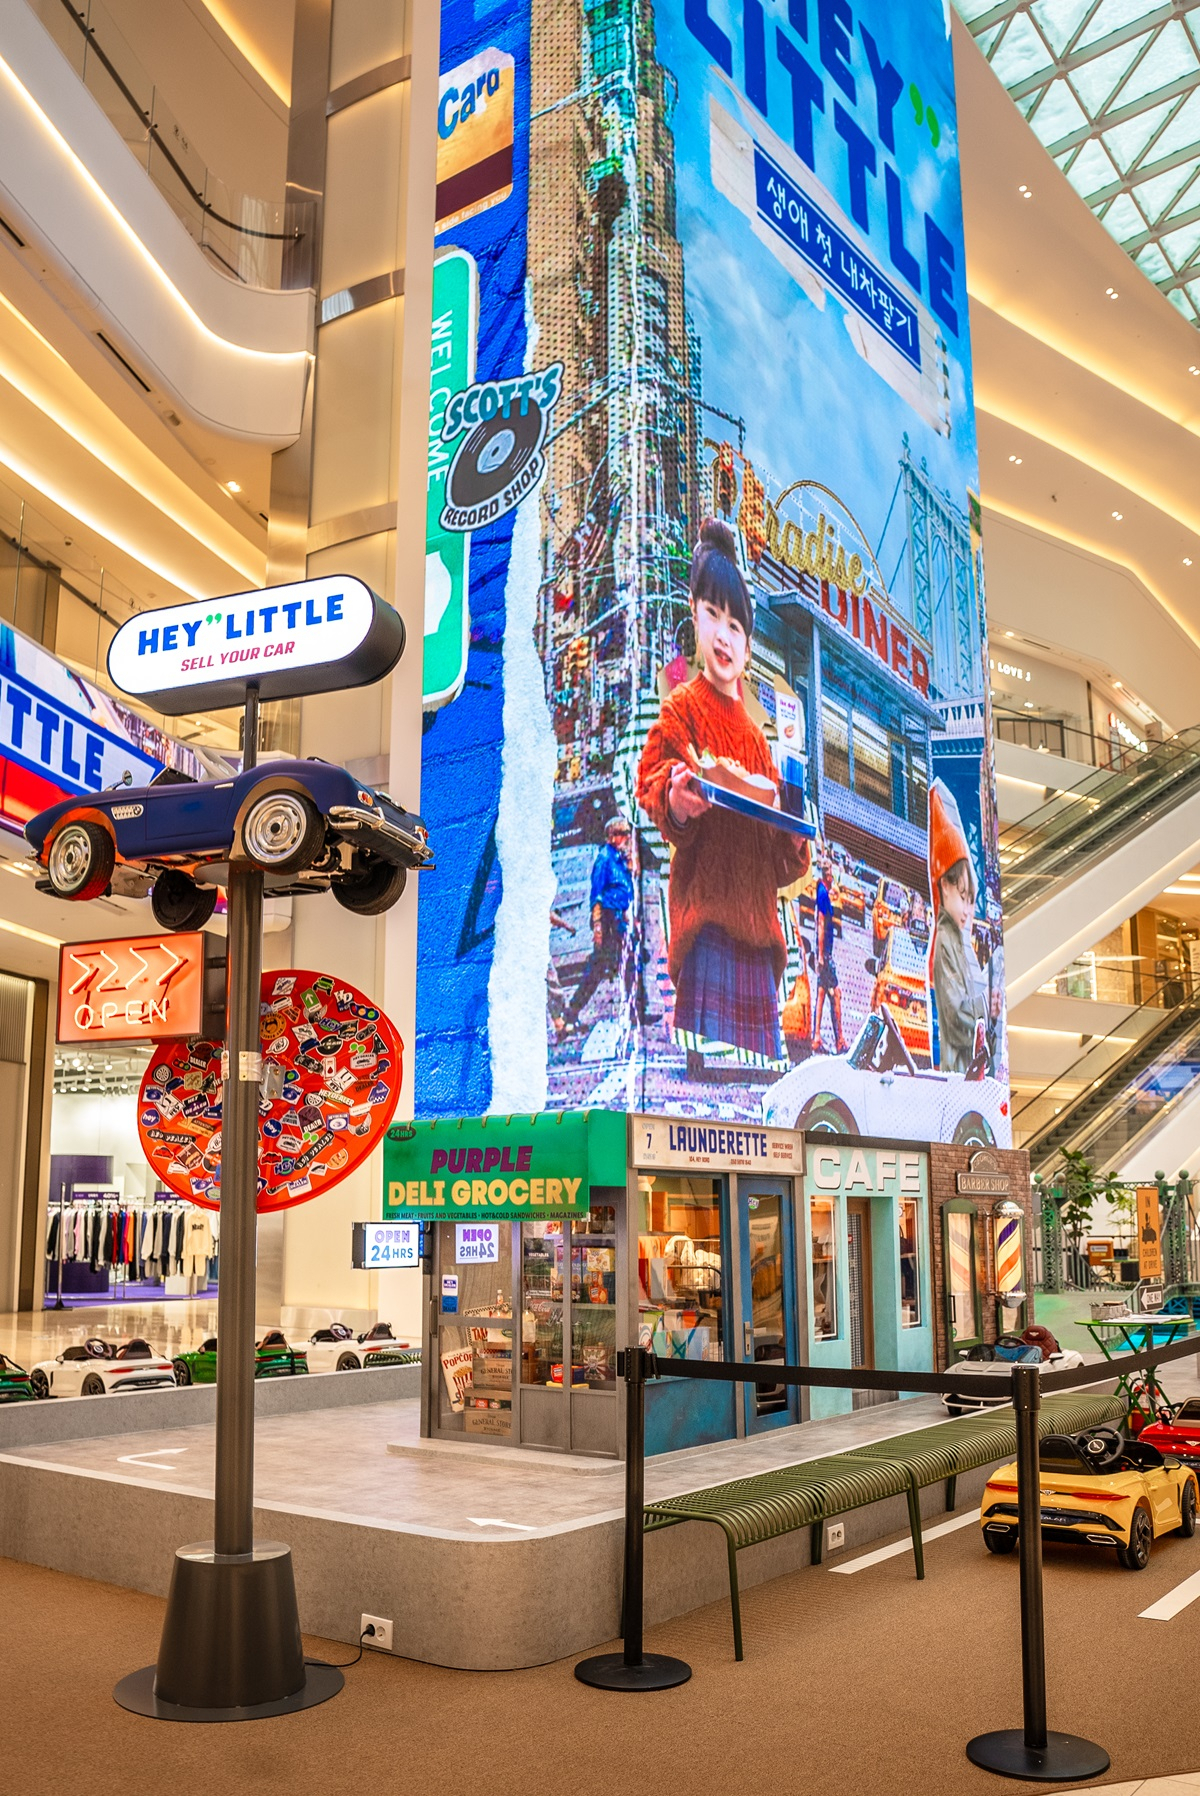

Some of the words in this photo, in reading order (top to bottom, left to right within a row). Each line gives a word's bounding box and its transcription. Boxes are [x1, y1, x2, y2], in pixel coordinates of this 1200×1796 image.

[766, 176, 809, 243] 생애
[815, 223, 833, 268] 첫
[446, 367, 558, 435] SCOTT'S
[443, 500, 499, 527] RECORD
[504, 456, 540, 507] SHOP
[226, 593, 344, 640] LITTLE
[820, 578, 930, 700] DINER
[180, 655, 214, 672] SELL
[221, 647, 260, 664] YOUR
[263, 641, 296, 658] CAR
[74, 997, 168, 1030] OPEN
[646, 1133, 652, 1149] 7
[669, 1125, 767, 1157] LAUNDERETTE
[430, 1146, 533, 1174] PURPLE
[813, 1149, 920, 1192] CAFE
[388, 1181, 446, 1206] DELI
[451, 1178, 582, 1206] GROCERY
[961, 1177, 990, 1190] BARBER
[991, 1179, 1009, 1191] SHOP
[375, 1230, 410, 1243] OPEN
[1143, 1248, 1157, 1257] CHILDREN
